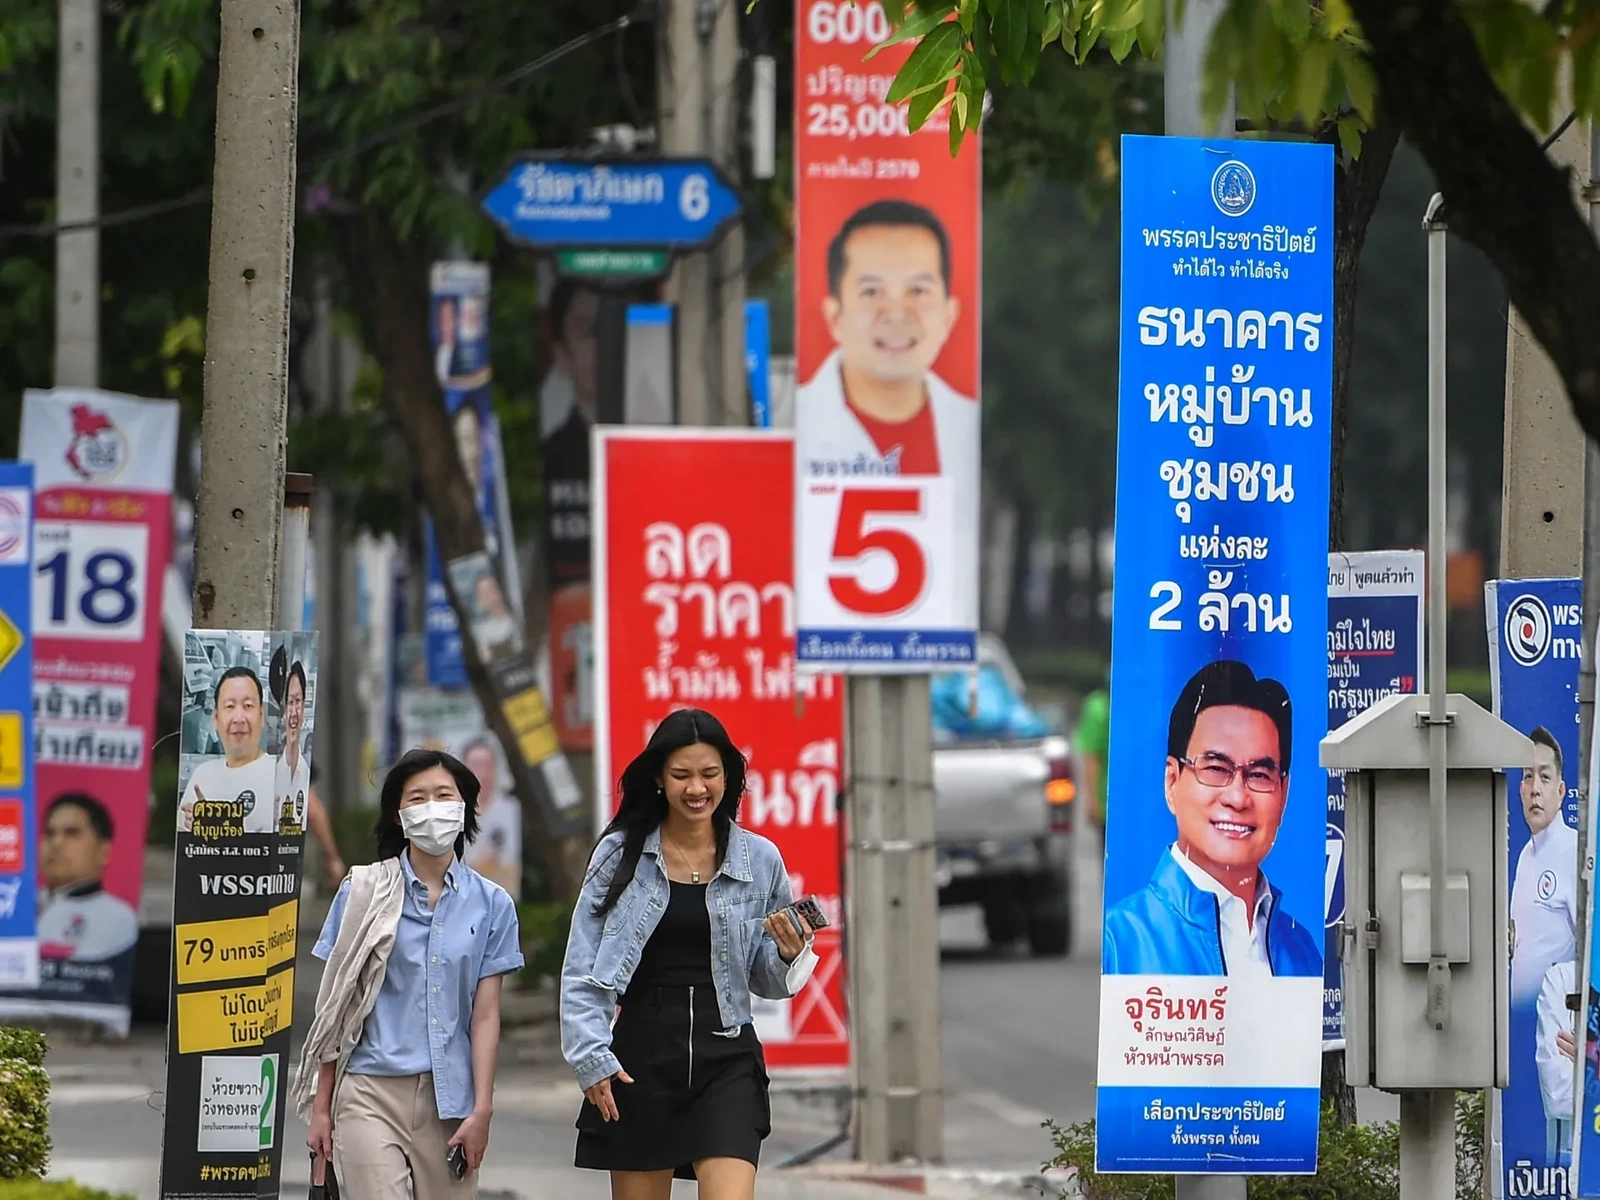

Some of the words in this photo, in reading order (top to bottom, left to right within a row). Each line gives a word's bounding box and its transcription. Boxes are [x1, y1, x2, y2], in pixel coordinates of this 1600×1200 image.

[678, 173, 710, 221] 6
[1142, 225, 1318, 253] พรรคประชาธิปัตย์
[1172, 257, 1226, 277] ทำได้ไว
[1229, 259, 1289, 280] ทำได้จริง
[1138, 305, 1323, 352] ธนาคาร
[1144, 364, 1313, 447] หมู่บ้าน
[1159, 458, 1295, 523] ชุมชน
[643, 521, 731, 579] ลด
[828, 488, 927, 618] 5
[1179, 524, 1269, 559] แห่งละ
[37, 548, 137, 626] 18
[1355, 567, 1414, 589] พูดแล้วทำ
[643, 582, 794, 640] ราคา
[1149, 580, 1182, 630] 2
[1198, 570, 1293, 634] ล้าน
[1552, 604, 1582, 626] พร
[643, 643, 741, 700] น้ำมัน
[194, 800, 243, 818] ศรราม
[183, 937, 214, 966] 79
[1125, 986, 1228, 1032] จุรินทร์
[1124, 1047, 1224, 1066] หัวหน้าพรรค
[202, 1097, 261, 1116] วังทองหล
[1143, 1099, 1286, 1122] เลือกประชาธิปัตย์
[1171, 1125, 1225, 1146] ทั้งพรรค
[1229, 1126, 1260, 1146] ทั้งคน
